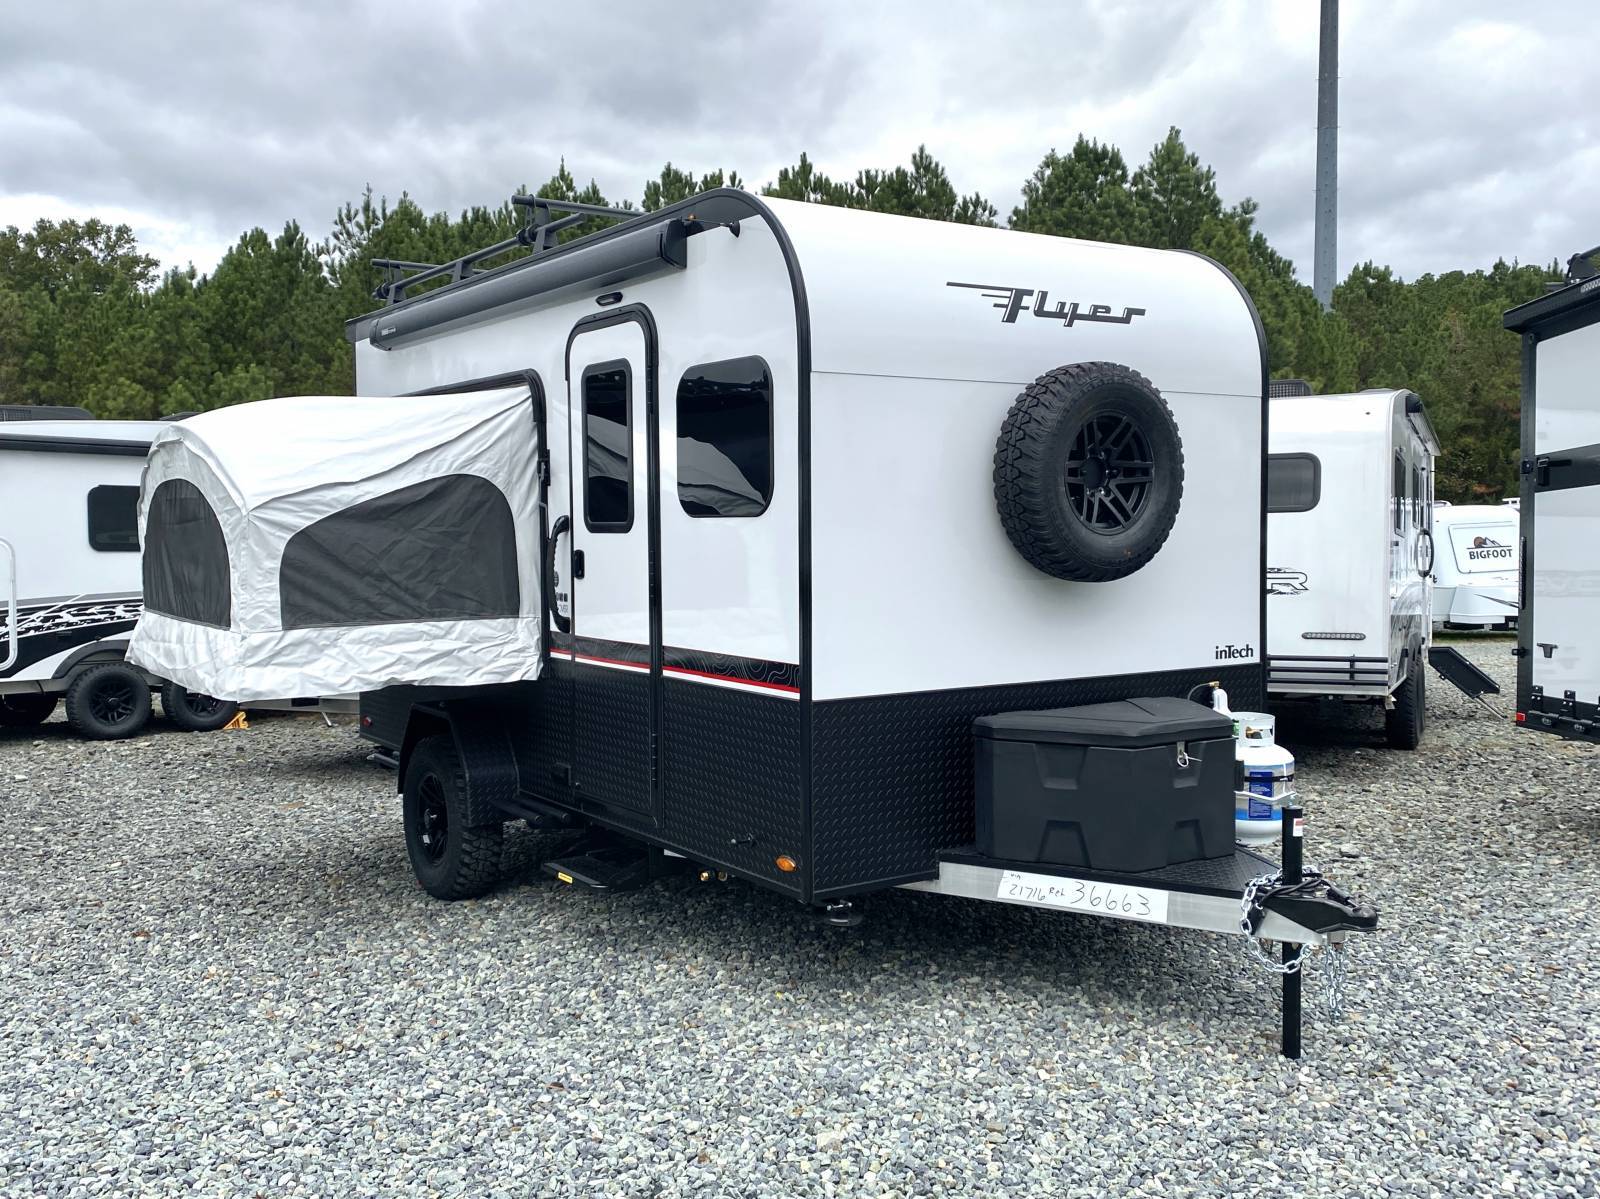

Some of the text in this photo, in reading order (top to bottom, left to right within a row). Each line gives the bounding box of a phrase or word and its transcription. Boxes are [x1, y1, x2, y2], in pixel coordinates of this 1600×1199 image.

[946, 281, 1146, 327] Flyer
[1469, 549, 1512, 560] BIGFOOT
[1215, 644, 1254, 660] inTech
[1009, 883, 1046, 901] 21716
[1070, 881, 1151, 916] 36663
